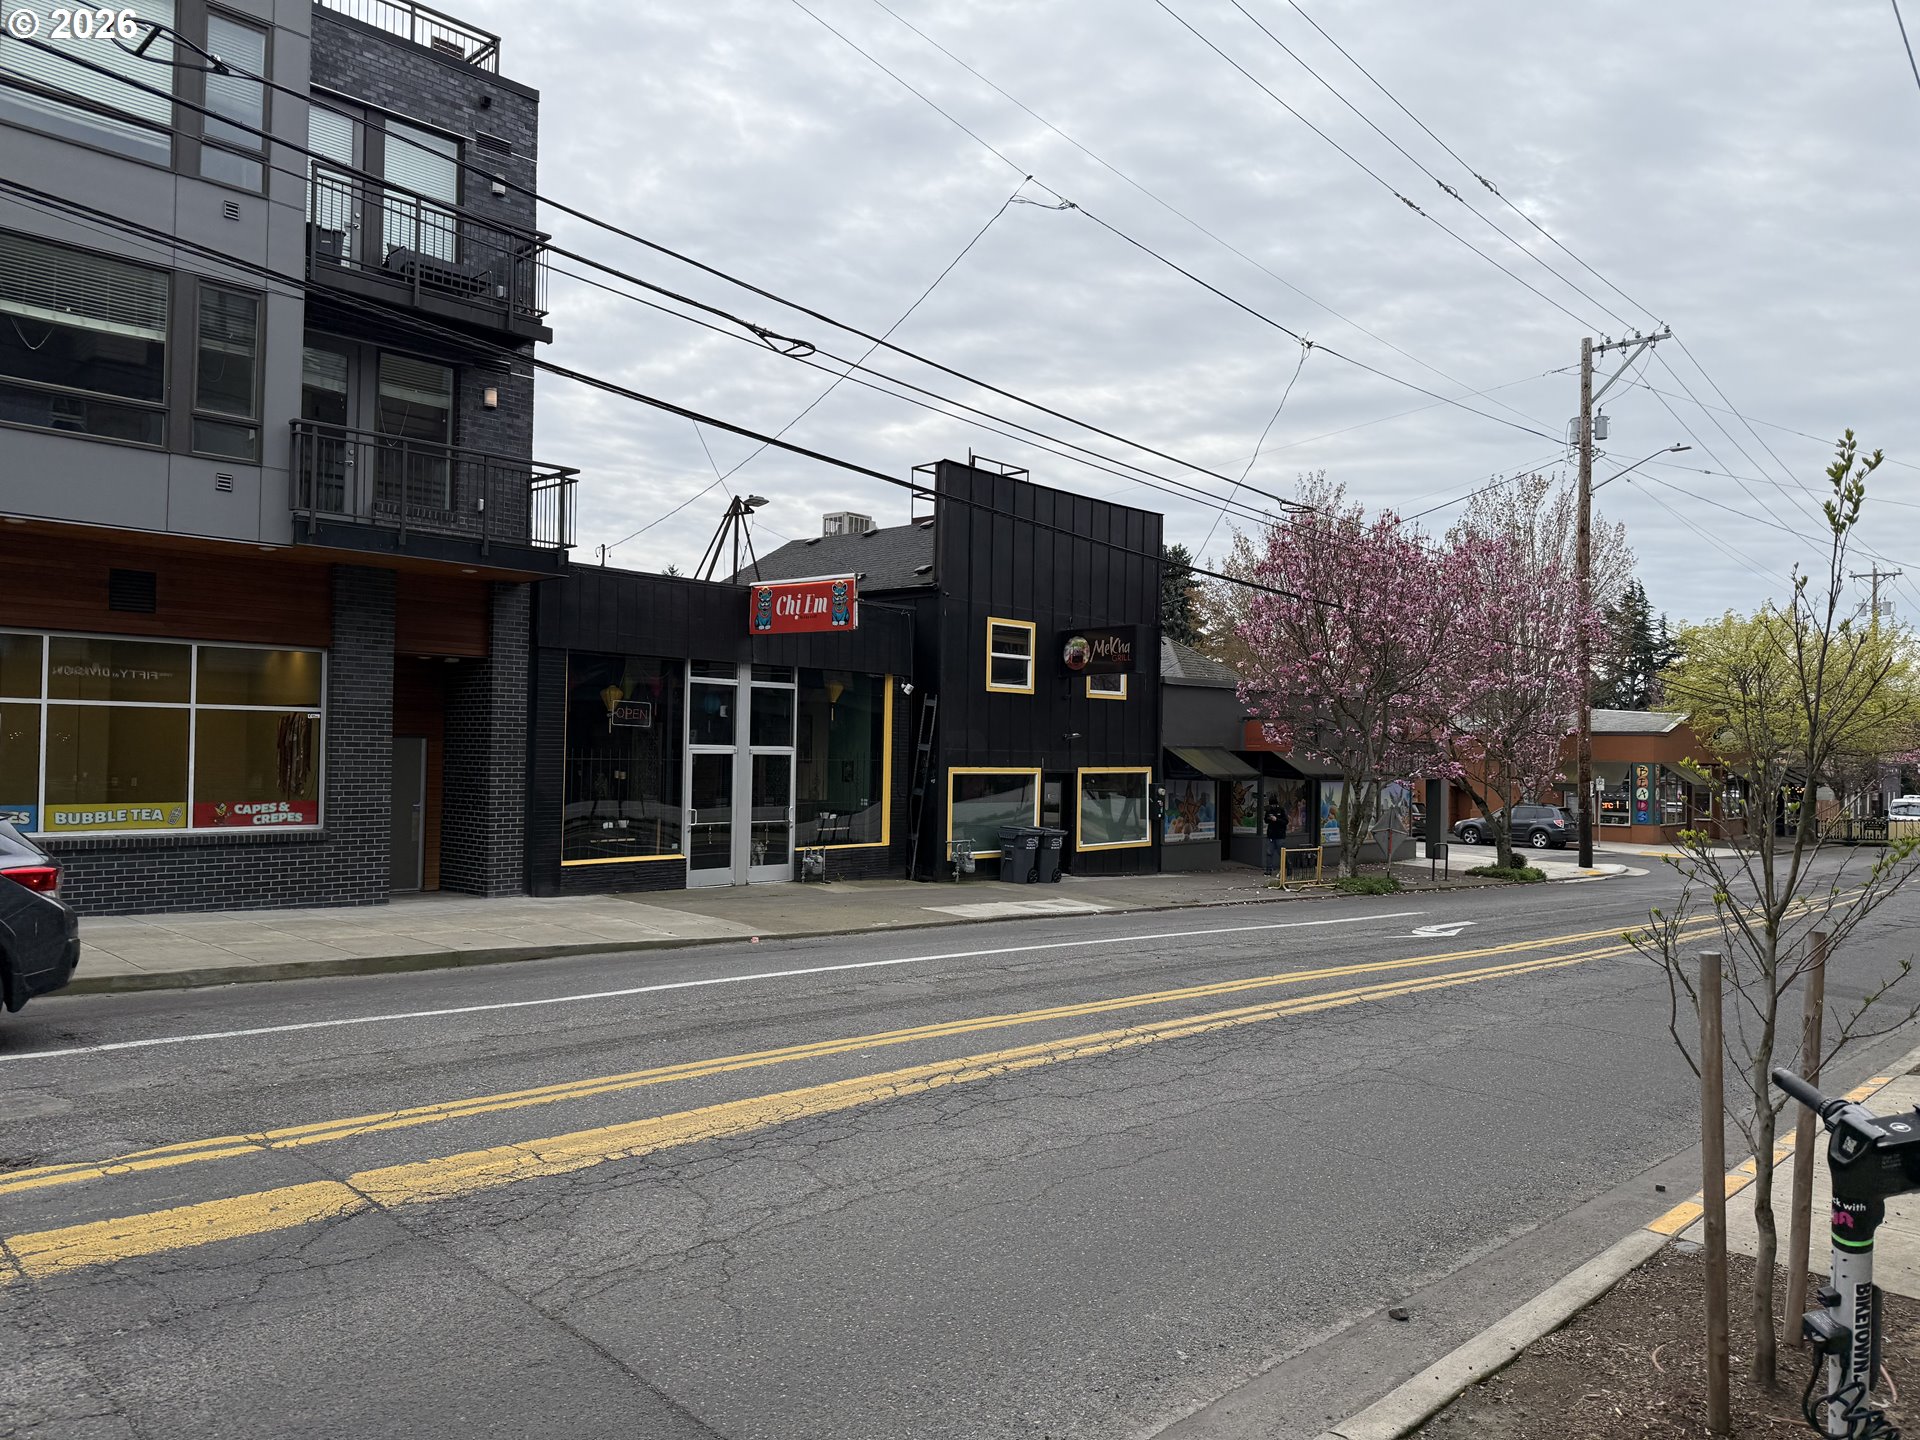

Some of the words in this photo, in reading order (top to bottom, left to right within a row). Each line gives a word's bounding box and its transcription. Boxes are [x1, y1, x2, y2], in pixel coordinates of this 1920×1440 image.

[804, 594, 828, 614] Em
[616, 707, 648, 720] OPEN
[54, 809, 127, 824] BUBBLE
[130, 807, 165, 821] TEA
[233, 803, 277, 815] CAPES
[278, 802, 290, 813] &
[6, 811, 31, 825] ES
[251, 812, 304, 824] CREPES
[1832, 1197, 1842, 1207] ck
[1842, 1203, 1867, 1212] with
[1854, 1283, 1871, 1373] BIKETOWN
